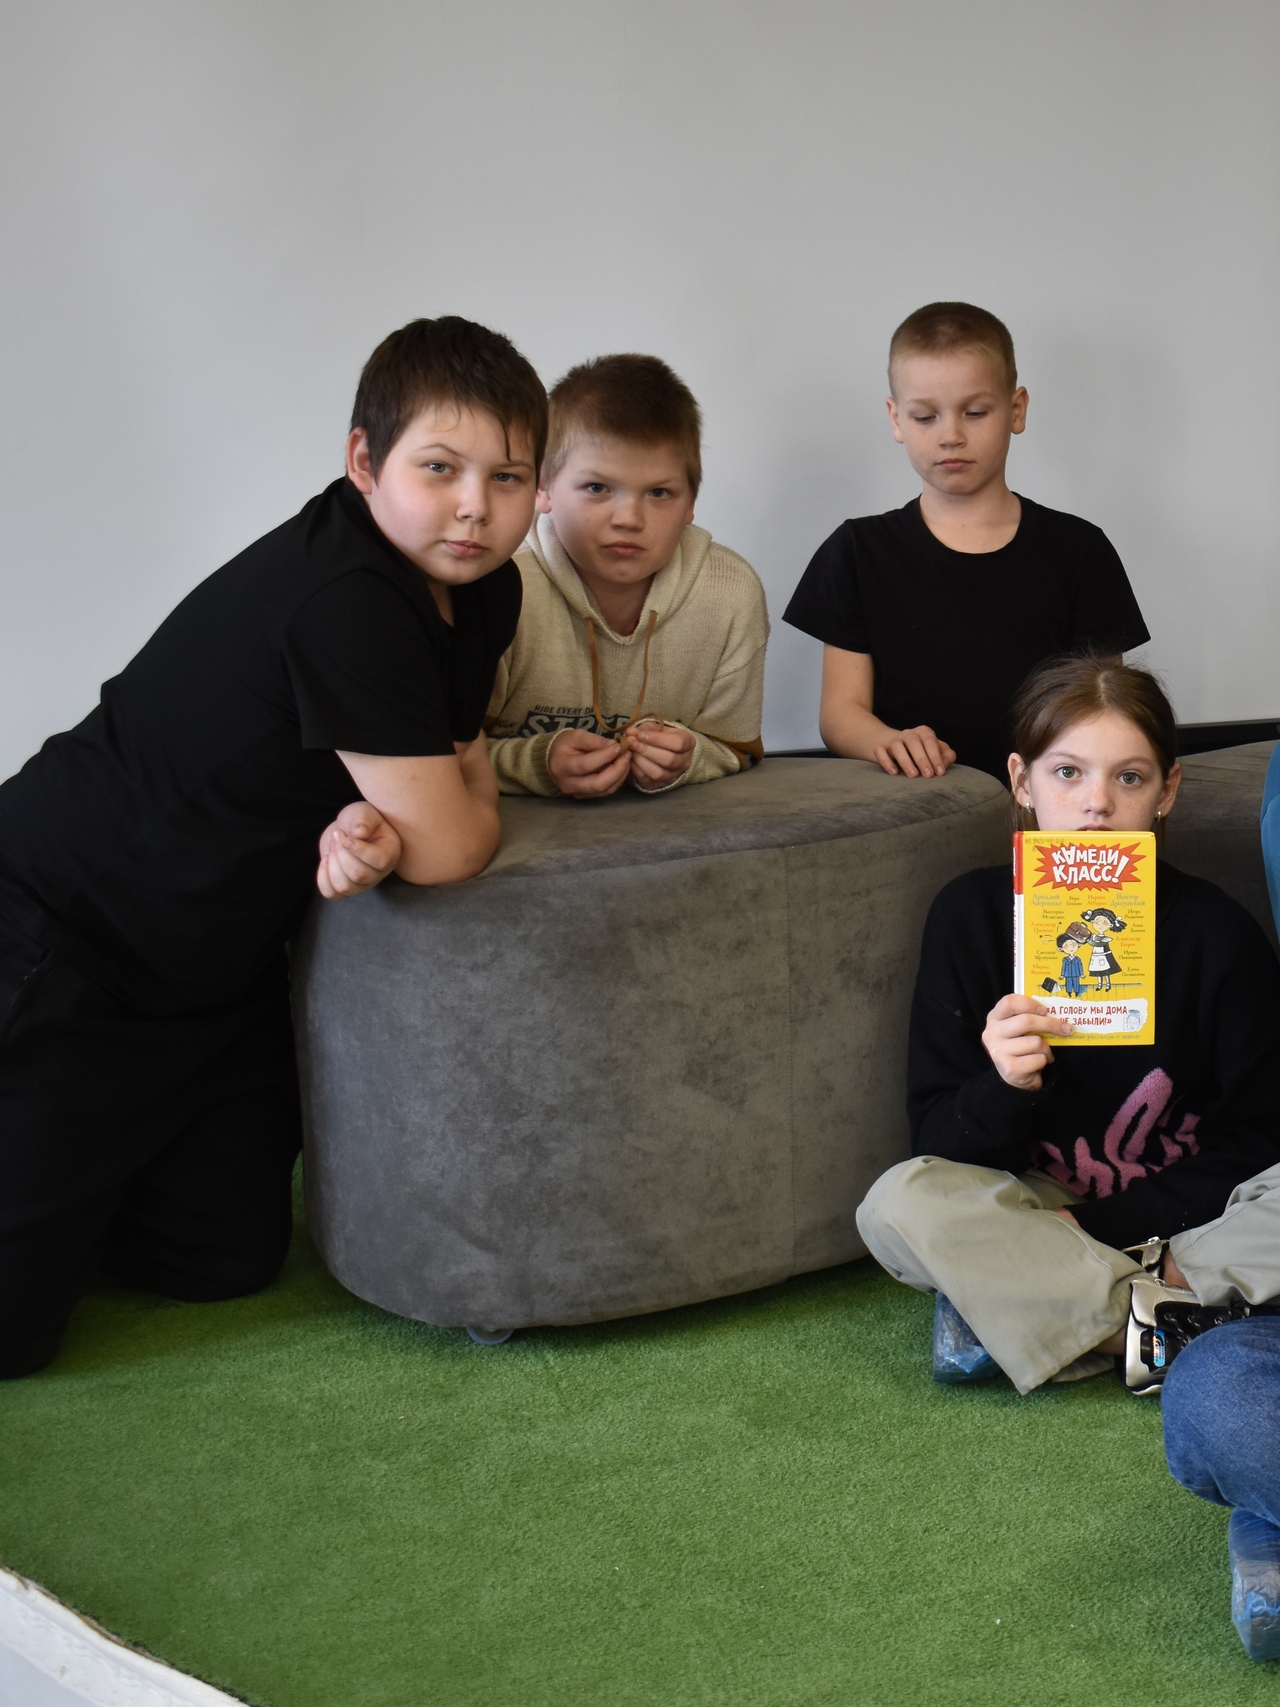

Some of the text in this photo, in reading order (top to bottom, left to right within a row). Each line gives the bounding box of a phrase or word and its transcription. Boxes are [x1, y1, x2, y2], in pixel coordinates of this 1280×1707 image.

[534, 705, 554, 714] RIDE
[557, 706, 582, 715] EVERY
[1052, 856, 1130, 884] КЛАСС!
[1116, 893, 1139, 902] Виктор
[1110, 900, 1146, 908] Драгунский
[1059, 1006, 1087, 1015] ГОЛОВУ
[1090, 1006, 1104, 1015] МЫ
[1106, 1006, 1128, 1016] ДОМА
[1072, 1018, 1112, 1026] ЗАБЫЛИ!»
